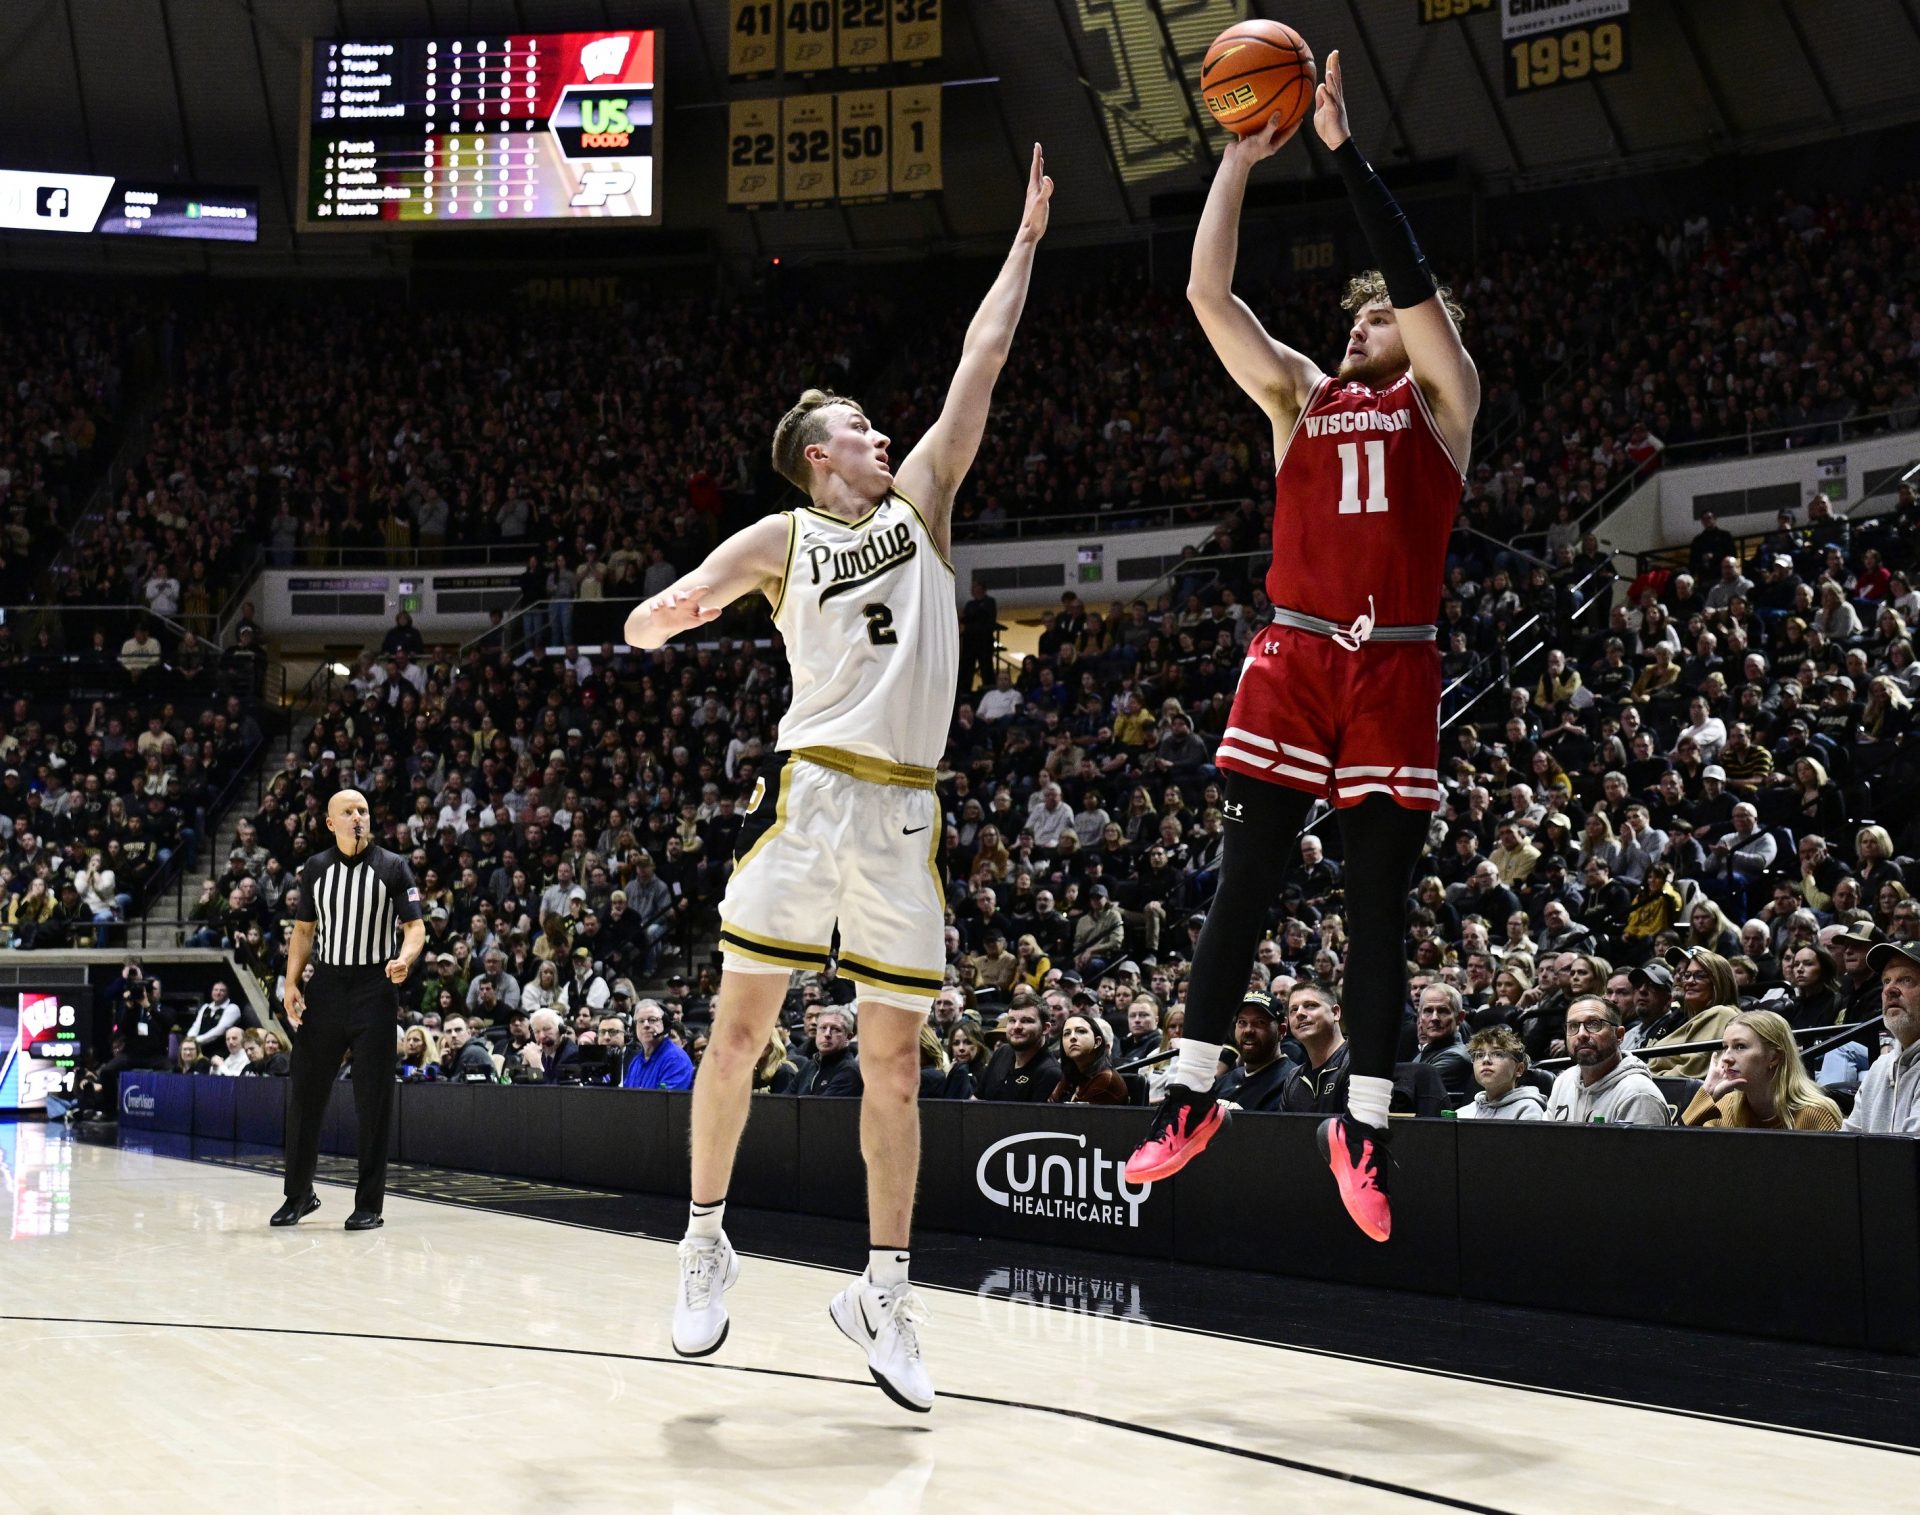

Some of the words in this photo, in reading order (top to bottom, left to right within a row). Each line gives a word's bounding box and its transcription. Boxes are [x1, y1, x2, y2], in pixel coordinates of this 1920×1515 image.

[736, 5, 771, 35] 41
[788, 1, 830, 33] 40
[842, 0, 884, 29] 22
[897, 0, 937, 23] 32
[329, 45, 337, 56] 7
[428, 43, 436, 54] 0
[453, 42, 461, 54] 0
[477, 41, 486, 53] 0
[505, 41, 510, 52] 1
[530, 41, 535, 51] 1
[1511, 21, 1623, 90] 1999
[455, 58, 460, 69] 1
[480, 57, 485, 68] 1
[504, 57, 510, 67] 1
[527, 56, 536, 67] 0
[326, 76, 337, 87] 11
[452, 73, 460, 84] 0
[479, 73, 485, 84] 1
[502, 72, 510, 83] 0
[527, 71, 535, 82] 0
[321, 91, 336, 103] 22
[427, 89, 435, 100] 0
[451, 88, 460, 100] 0
[479, 88, 484, 99] 1
[501, 87, 510, 99] 0
[527, 87, 535, 98] 0
[426, 104, 435, 116] 0
[454, 104, 459, 115] 1
[478, 104, 484, 114] 1
[501, 103, 510, 114] 0
[529, 102, 534, 113] 1
[426, 122, 434, 133] P
[475, 122, 484, 132] A
[911, 121, 923, 153] 1
[328, 142, 334, 153] 1
[450, 139, 459, 151] 0
[475, 139, 484, 151] 0
[500, 138, 510, 150] 0
[527, 137, 534, 149] 1
[581, 132, 629, 149] FOODS
[732, 133, 774, 165] 22
[788, 130, 829, 163] 32
[843, 125, 883, 159] 50
[450, 155, 458, 167] 2
[477, 155, 483, 166] 1
[499, 153, 509, 166] 0
[525, 153, 534, 166] 0
[424, 171, 433, 183] 0
[449, 170, 459, 183] 0
[474, 170, 483, 182] 4
[499, 169, 509, 181] 0
[527, 169, 534, 181] 1
[324, 188, 332, 200] 4
[451, 186, 458, 198] 1
[476, 185, 483, 198] 1
[499, 185, 509, 197] 0
[524, 184, 534, 197] 0
[448, 201, 458, 214] 0
[473, 200, 483, 213] 0
[498, 200, 508, 212] 0
[523, 199, 533, 212] 0
[1305, 409, 1412, 439] WISCONSIN
[1338, 440, 1388, 514] 11
[807, 522, 917, 585] Purdue
[863, 603, 898, 645] 2
[59, 1006, 75, 1026] 8
[47, 1072, 75, 1092] 21
[1324, 1082, 1335, 1095] P
[1013, 1195, 1124, 1226] HEALTHCARE
